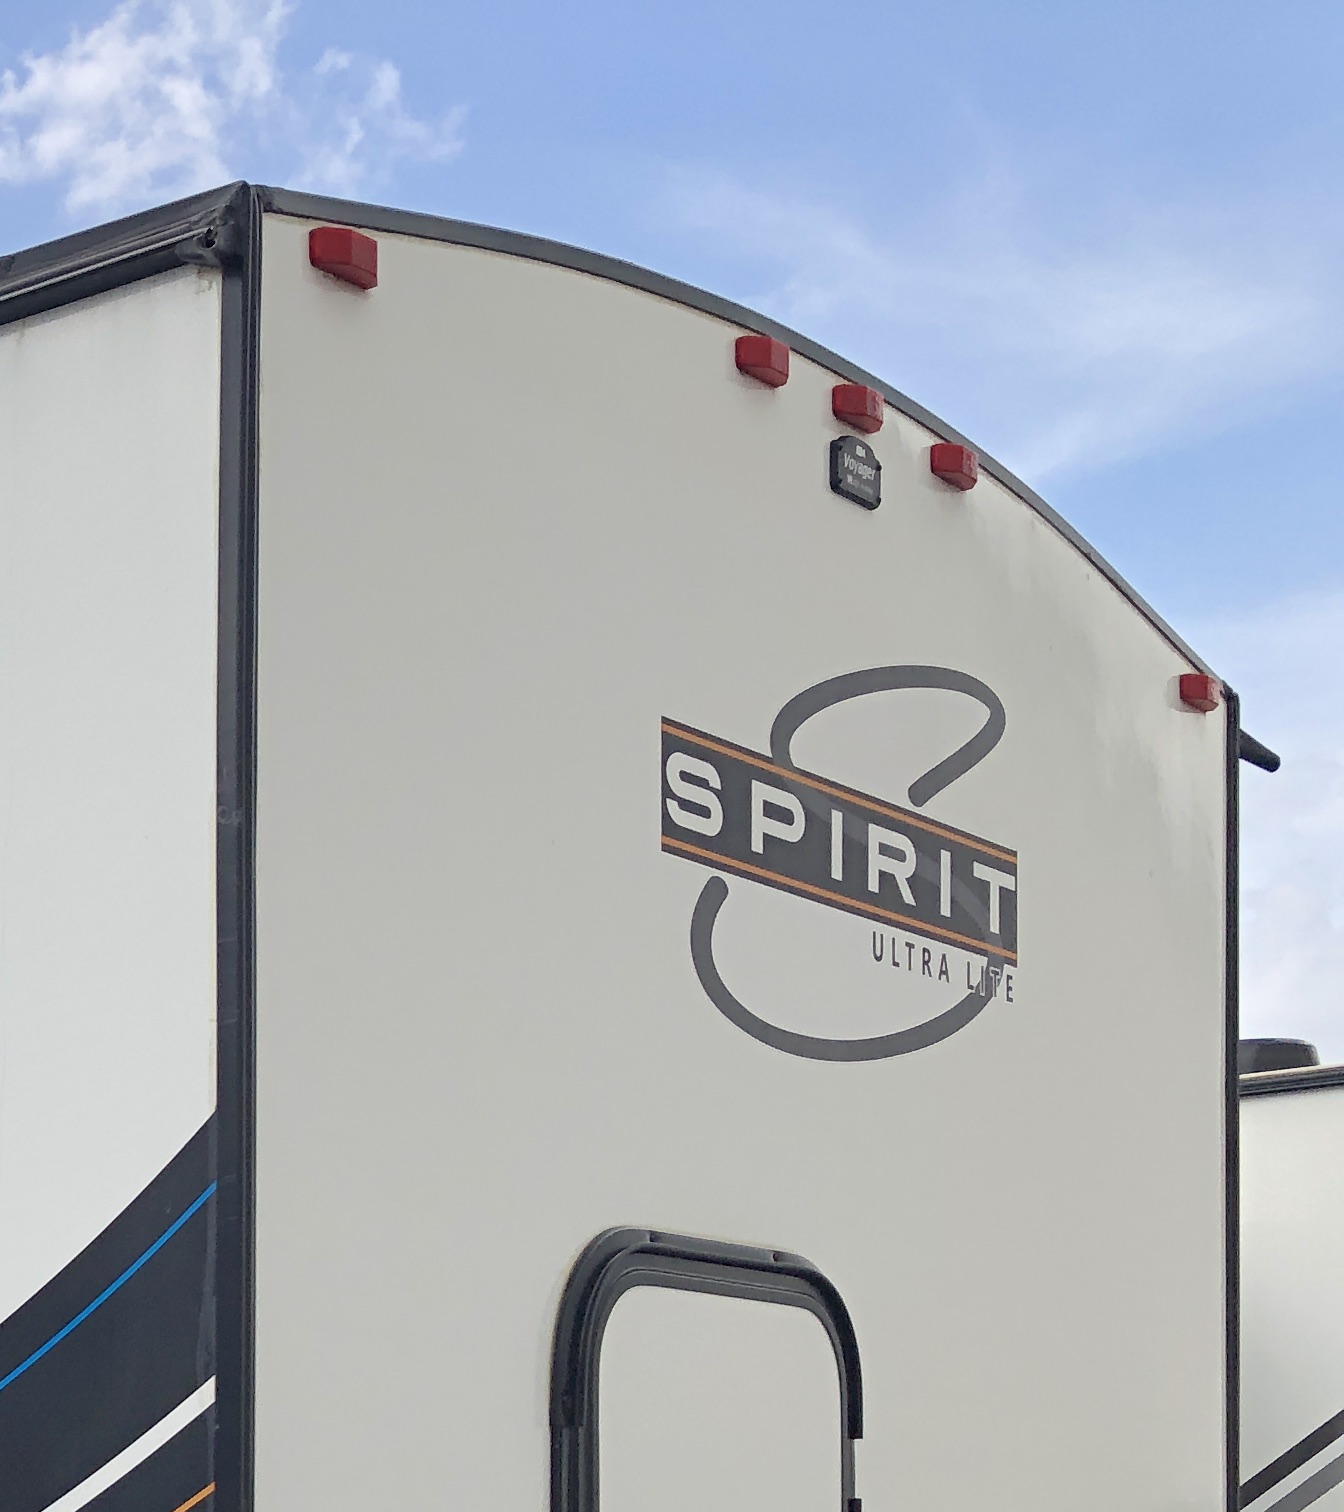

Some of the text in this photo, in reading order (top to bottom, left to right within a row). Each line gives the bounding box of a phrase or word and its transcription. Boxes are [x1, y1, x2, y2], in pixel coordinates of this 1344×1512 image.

[844, 453, 876, 480] Voyager
[665, 751, 1016, 934] SPIRIT
[872, 930, 1014, 1003] ULTRA LITE
